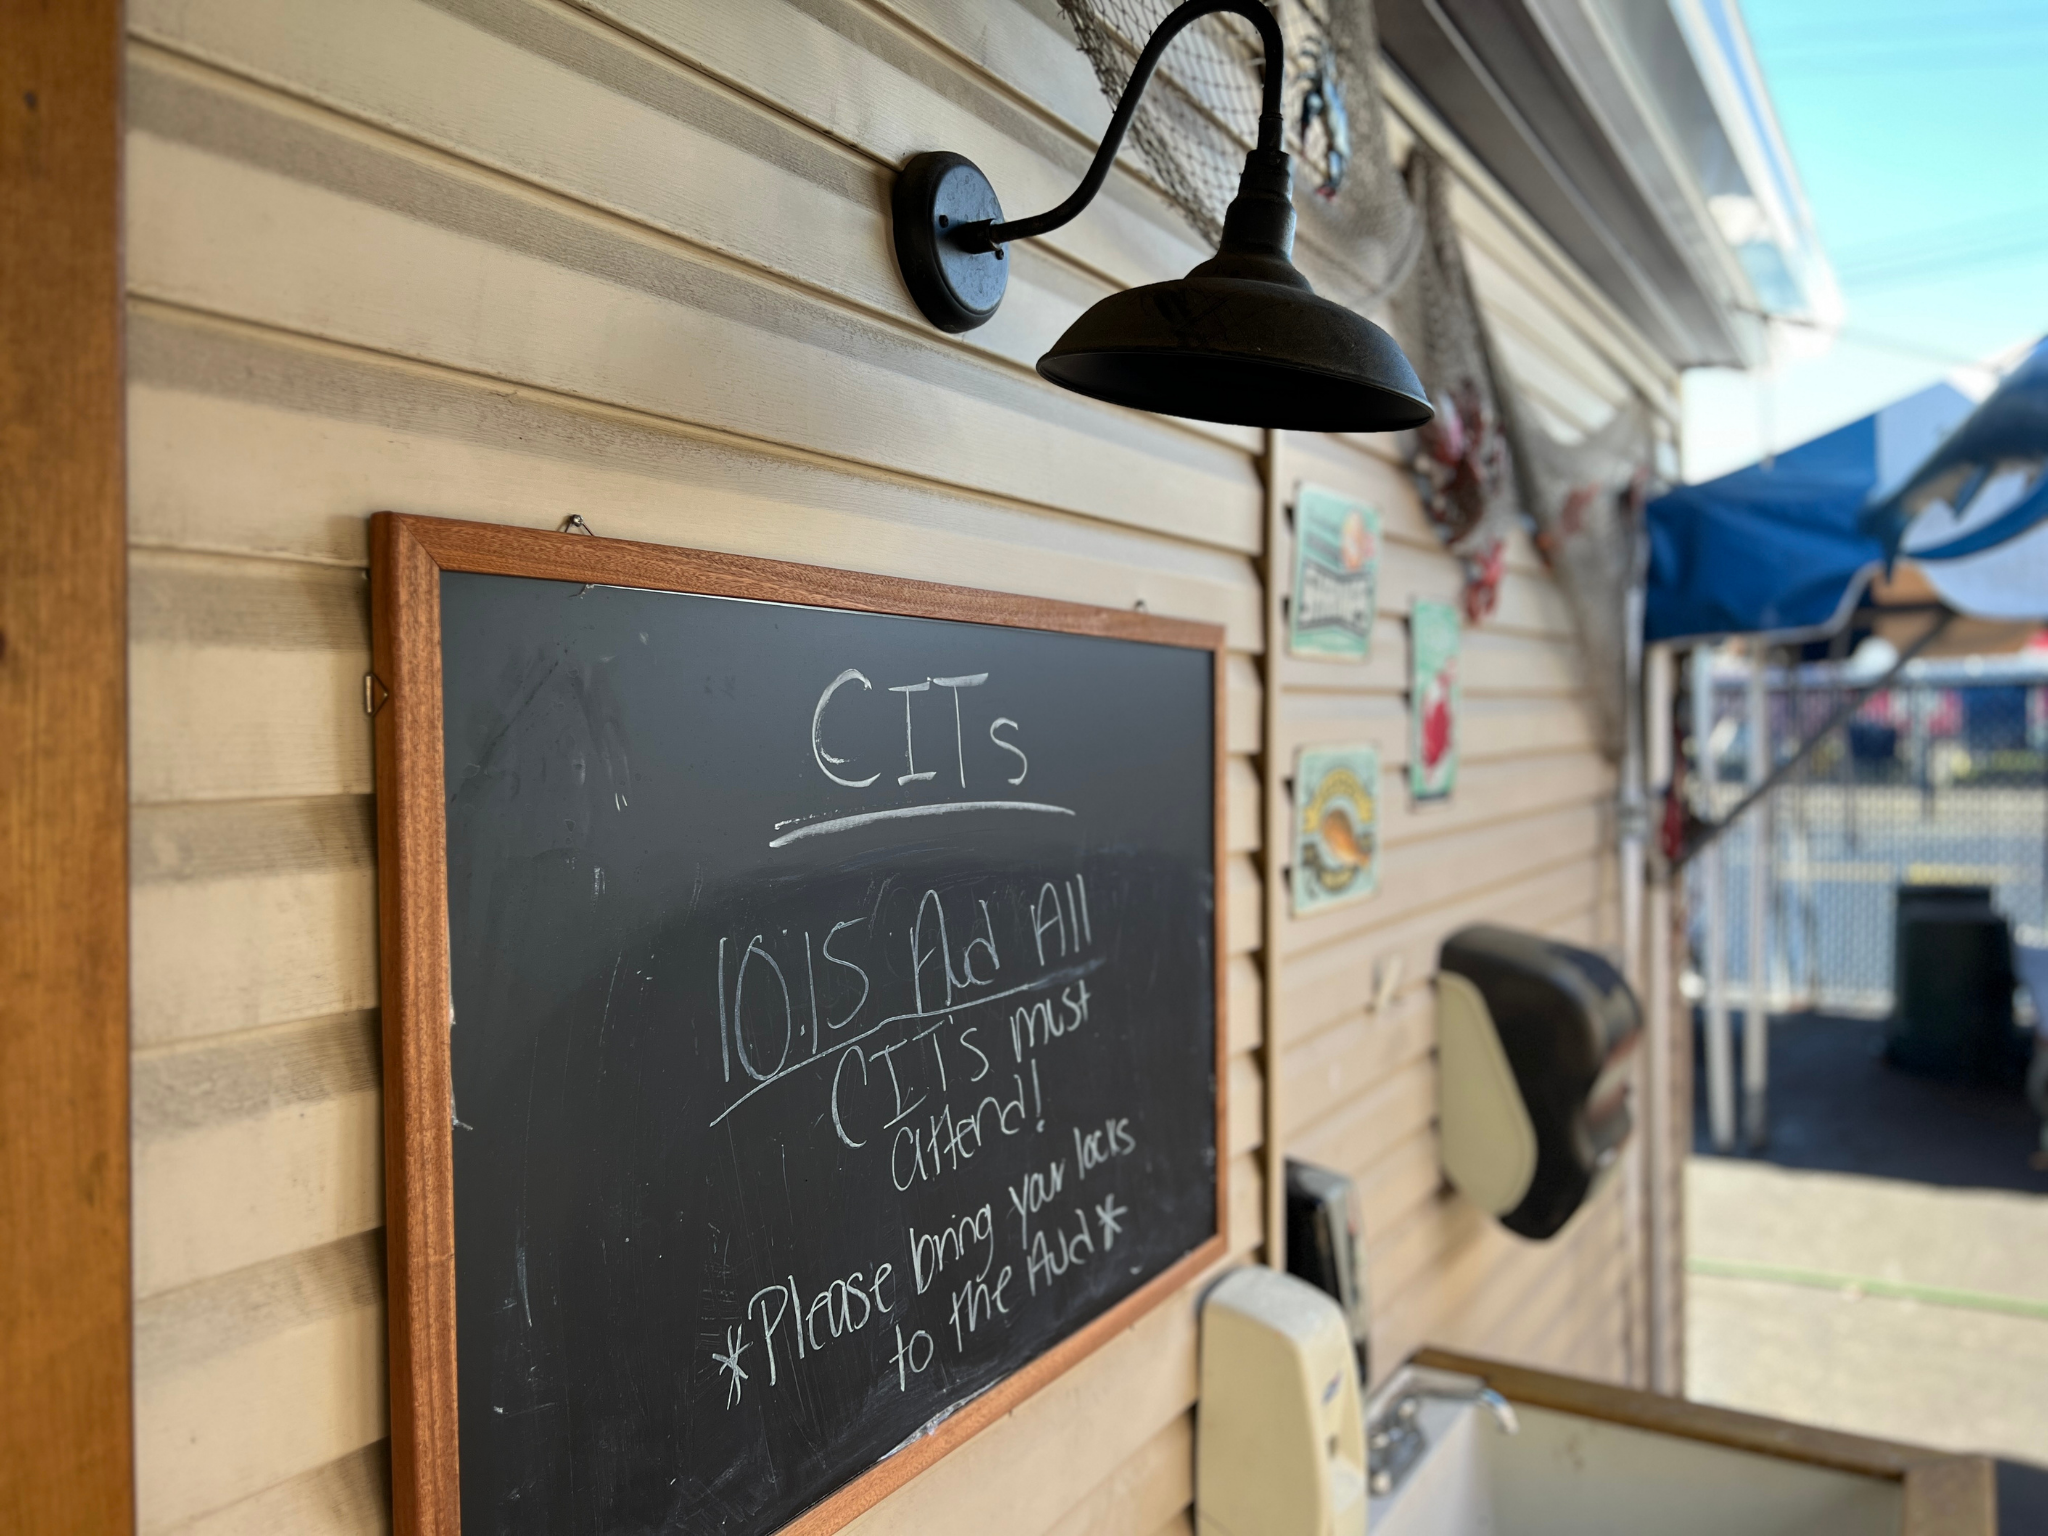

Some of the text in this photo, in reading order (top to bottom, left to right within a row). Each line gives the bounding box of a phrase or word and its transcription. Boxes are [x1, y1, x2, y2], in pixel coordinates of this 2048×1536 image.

[812, 668, 1028, 788] CITs
[1030, 873, 1091, 967] All
[892, 1058, 1046, 1191] attend!
[909, 1203, 994, 1296] bring
[1009, 1161, 1066, 1250] your
[1073, 1118, 1137, 1181] locks
[889, 1323, 935, 1393] to
[949, 1265, 1013, 1353] the
